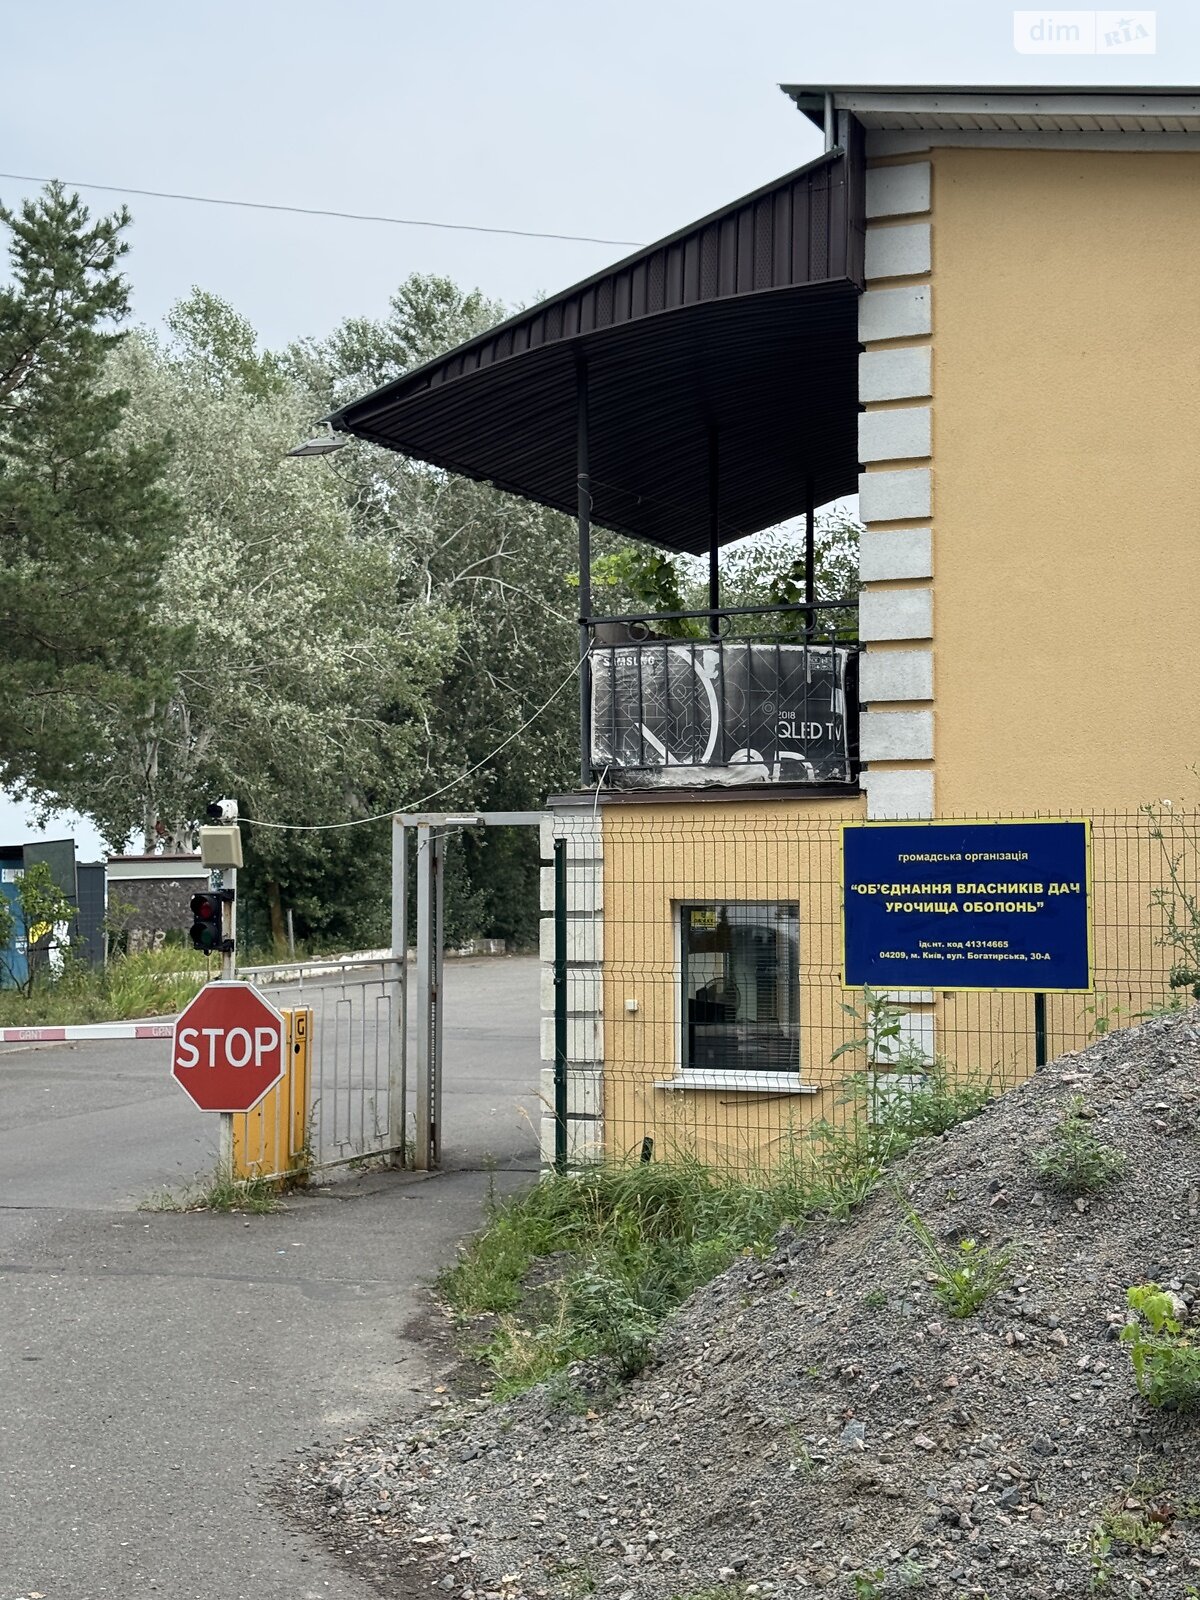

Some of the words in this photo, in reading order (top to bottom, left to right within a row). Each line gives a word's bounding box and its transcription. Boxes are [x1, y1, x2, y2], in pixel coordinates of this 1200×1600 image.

[774, 720, 823, 740] QLED
[825, 722, 843, 741] TV
[898, 853, 962, 864] громадська
[964, 851, 1029, 863] організація
[956, 883, 1044, 895] ВЛАСНИКІВ
[1048, 883, 1081, 896] ДАЧ
[885, 902, 959, 915] УРОЧИЩА
[964, 940, 1009, 949] 41314665
[879, 951, 909, 960] 04209,
[922, 952, 945, 960] Київ,
[946, 953, 965, 961] вул.
[967, 952, 1028, 961] Богатирська,
[19, 1029, 43, 1041] GANT
[151, 1026, 174, 1038] GAN
[176, 1027, 279, 1068] STOP
